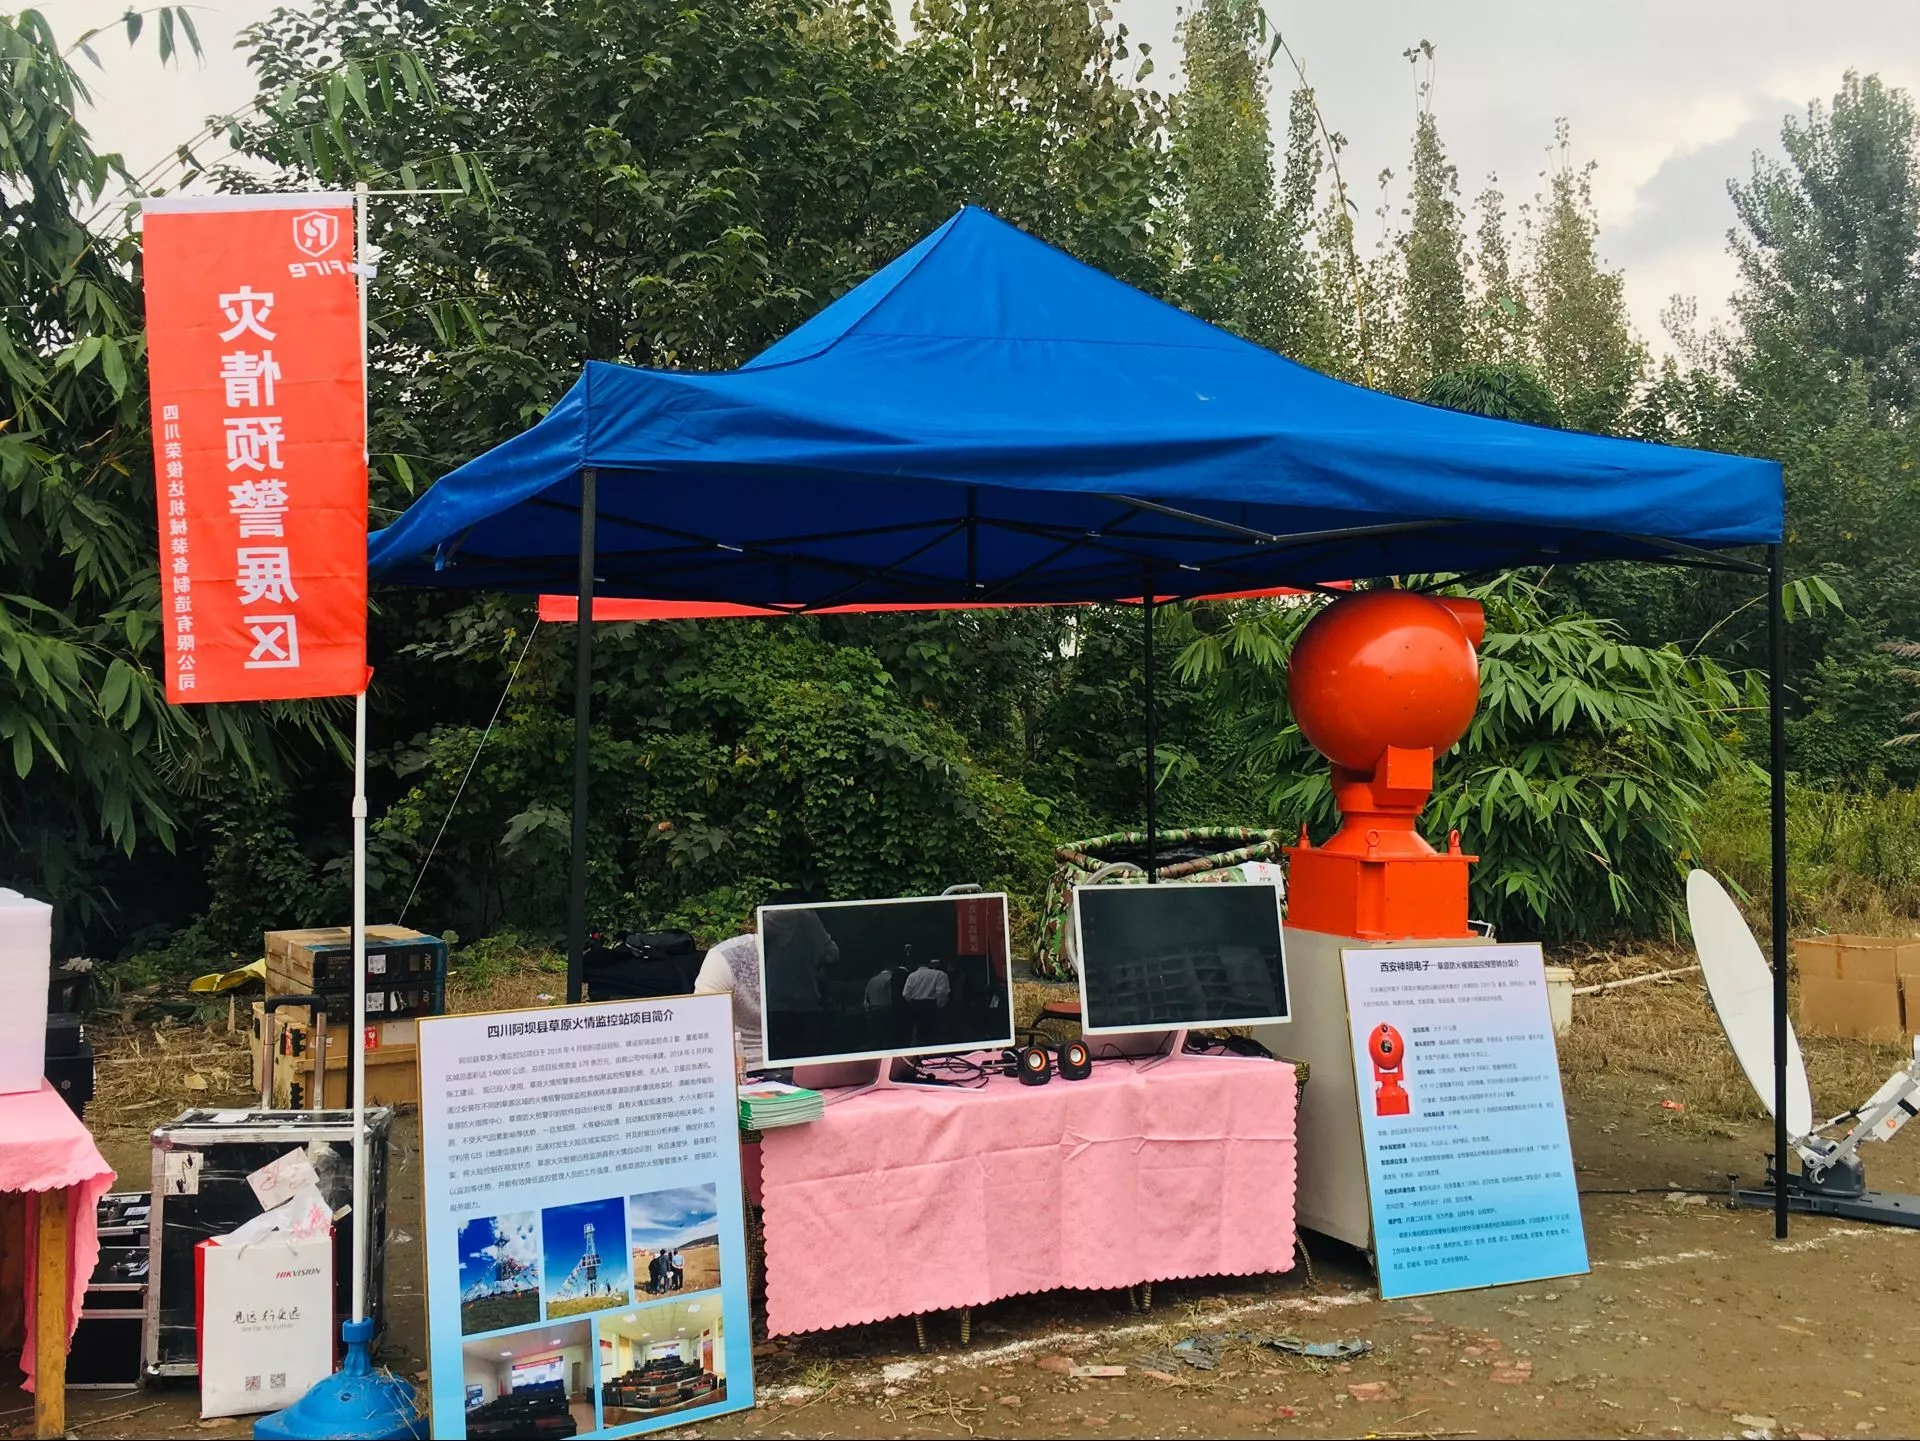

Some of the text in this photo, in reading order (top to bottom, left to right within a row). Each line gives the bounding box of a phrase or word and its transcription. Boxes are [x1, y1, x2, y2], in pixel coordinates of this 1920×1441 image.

[487, 1009, 674, 1038] 四川阿坝县草原火情监控站项目简介
[276, 1267, 321, 1279] HIKVISION
